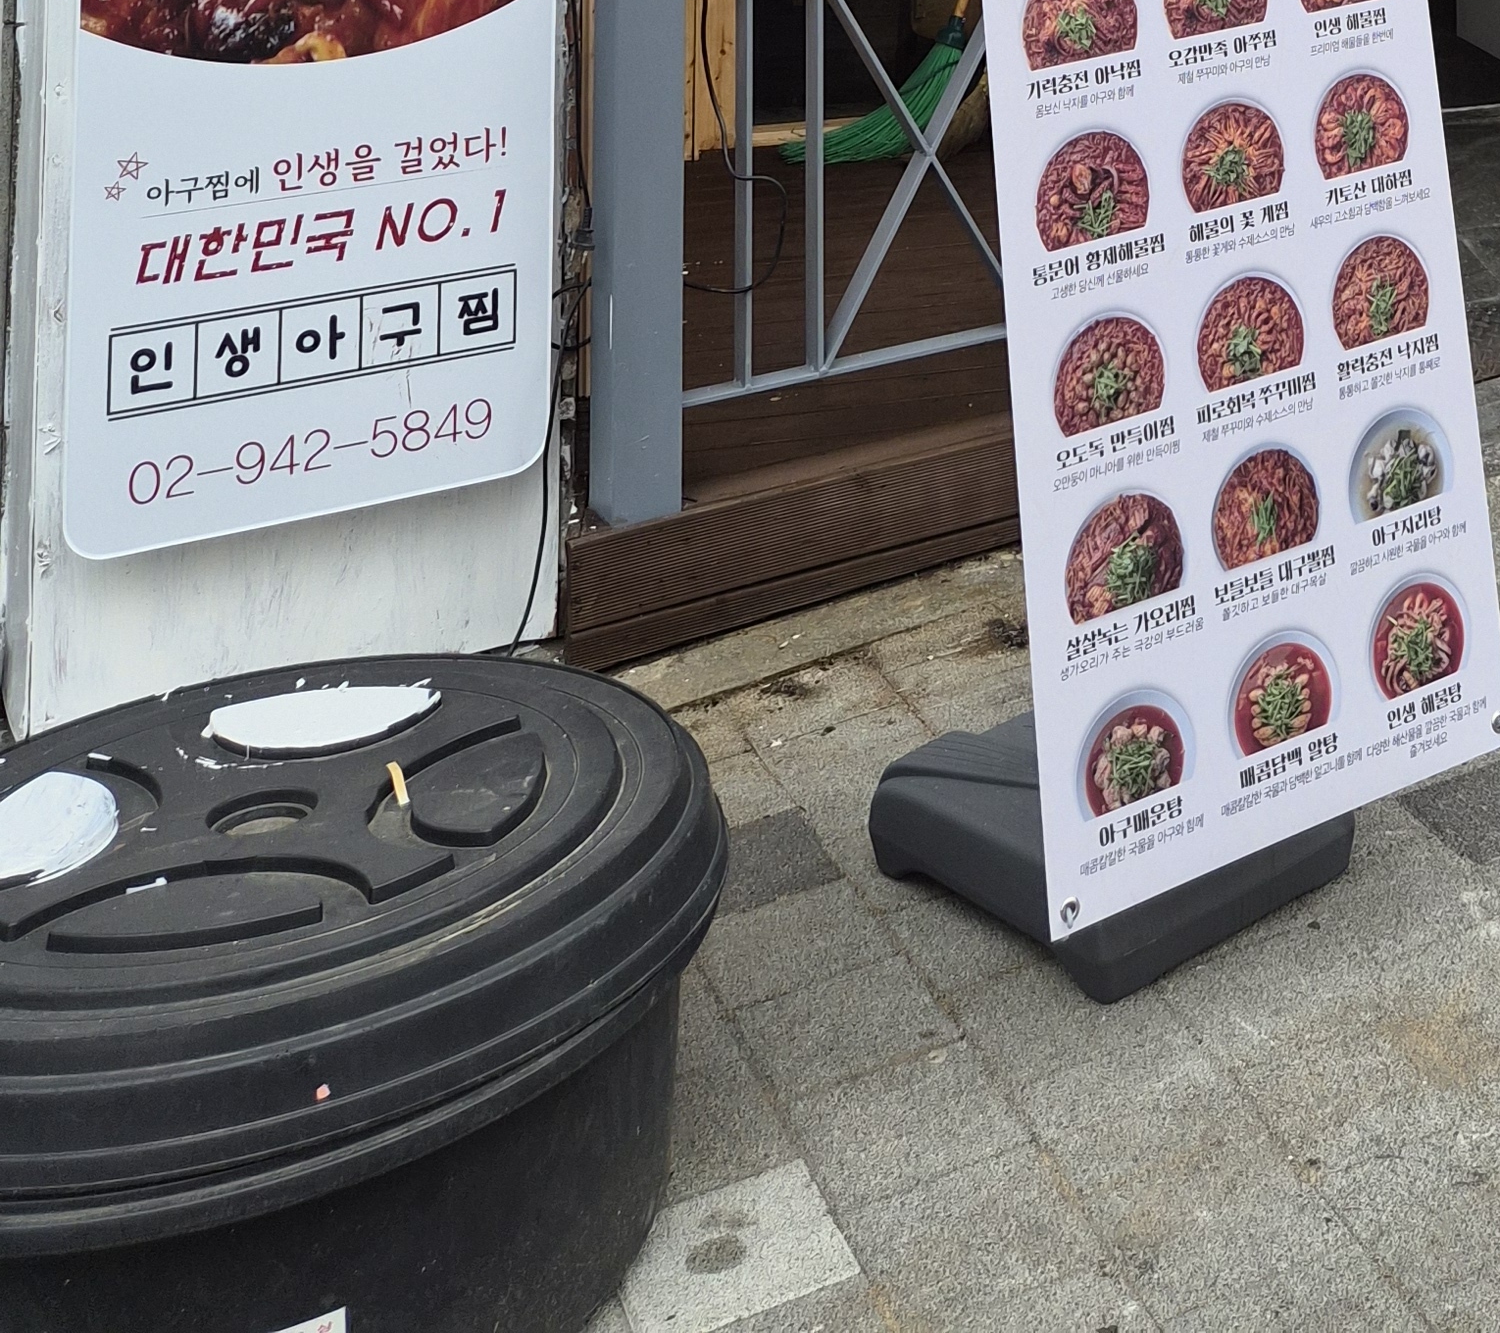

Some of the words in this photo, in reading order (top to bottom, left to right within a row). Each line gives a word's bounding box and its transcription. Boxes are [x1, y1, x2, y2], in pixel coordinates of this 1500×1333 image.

[1168, 39, 1228, 68] 오감만족
[1233, 29, 1277, 54] 아쭈찜
[1314, 16, 1342, 39] 인생
[1346, 7, 1387, 31] 해물찜
[1026, 70, 1090, 101] 기력충전
[1095, 59, 1142, 85] 아낙찜
[146, 166, 260, 208] 아구찜에
[272, 143, 382, 191] 인생을
[394, 126, 508, 175] 걸었다!
[1325, 180, 1367, 207] 키토산
[1371, 169, 1413, 194] 대하찜
[135, 208, 355, 285] 대한민국
[1188, 215, 1235, 243] 해물의
[1240, 210, 1255, 231] 꽃
[1260, 200, 1289, 225] 게찜
[1032, 256, 1080, 287] 통문어
[1085, 233, 1166, 272] 황제해물찜
[1337, 346, 1393, 382] 활력충전
[1397, 332, 1439, 360] 낙지찜
[1195, 390, 1256, 425] 피로회복
[1258, 371, 1317, 405] 쭈꾸미찜
[127, 398, 493, 506] 02-942-5849
[1056, 437, 1104, 472] 오도독
[1110, 415, 1176, 454] 만득이찜
[1371, 505, 1442, 547] 아구지리탕
[1214, 567, 1274, 606] 보들보들
[1277, 544, 1336, 582] 대구뽈찜
[1066, 621, 1129, 662] 살살녹는
[1133, 594, 1196, 636] 가오리찜
[1387, 701, 1417, 730] 인생
[1420, 681, 1462, 715] 해물탕
[1239, 746, 1303, 789] 매콤담백
[1307, 732, 1338, 763] 알탕
[1098, 795, 1184, 847] 아구매운탕
